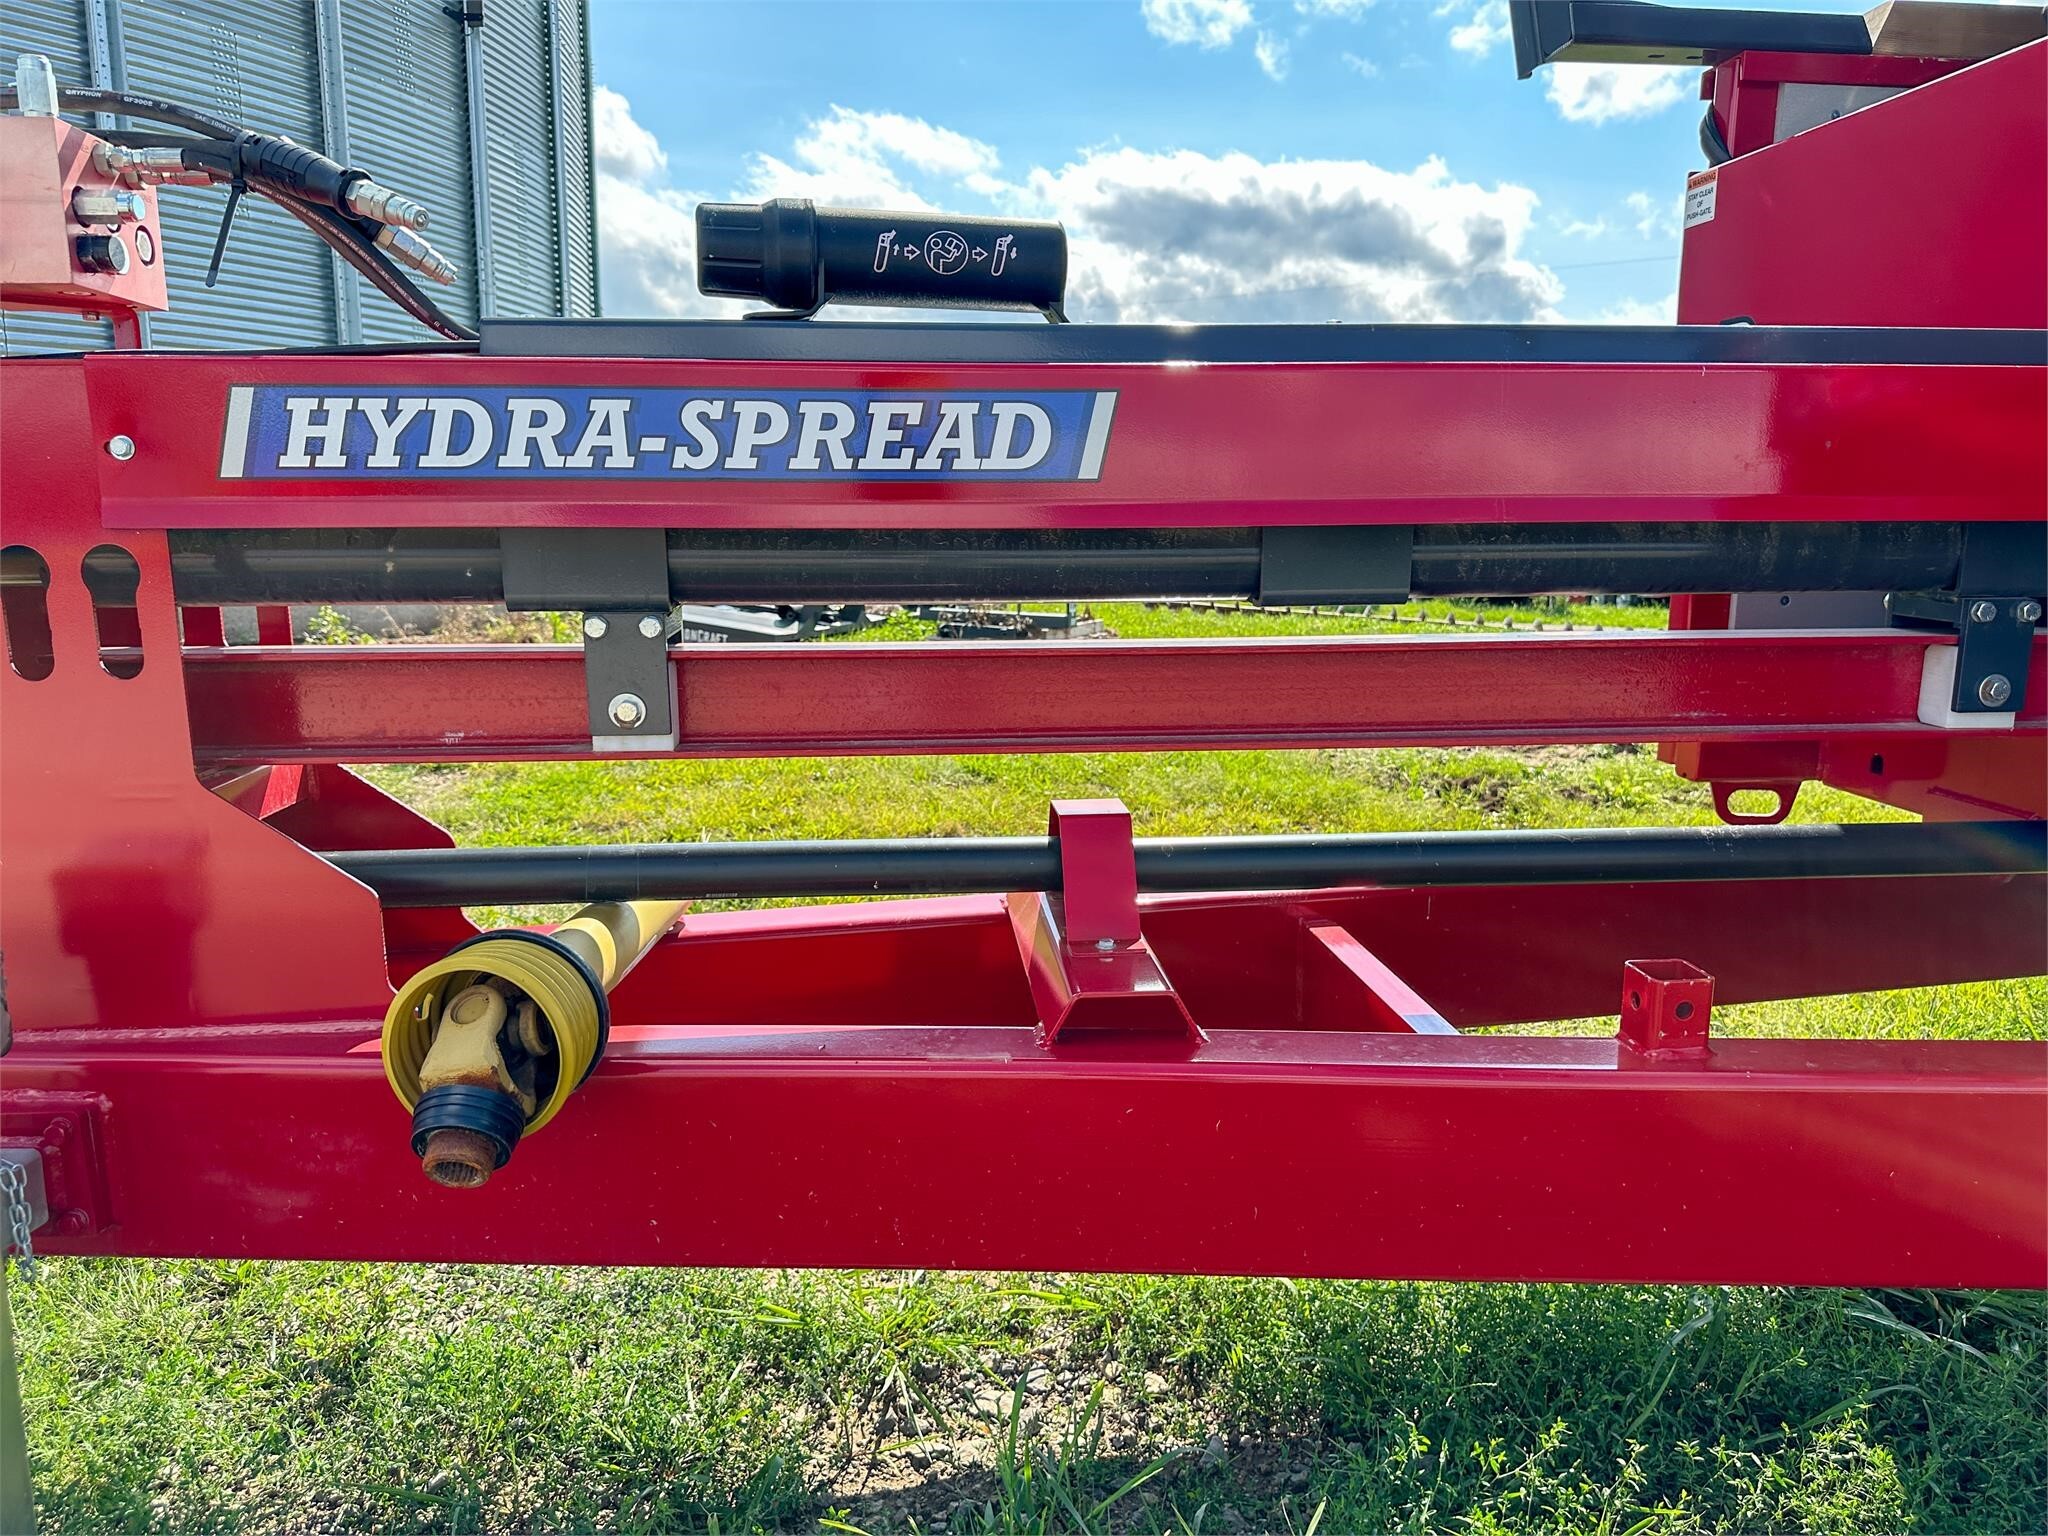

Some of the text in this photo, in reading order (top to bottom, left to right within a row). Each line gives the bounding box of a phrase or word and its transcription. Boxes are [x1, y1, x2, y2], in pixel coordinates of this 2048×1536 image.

[65, 89, 102, 98] GRYPHON
[1692, 172, 1716, 186] WARNING
[1688, 186, 1714, 202] STAY CLEAR
[1696, 200, 1703, 208] OF
[278, 396, 1053, 471] HYDRA-SPREAD
[684, 628, 729, 643] ONCRAFT
